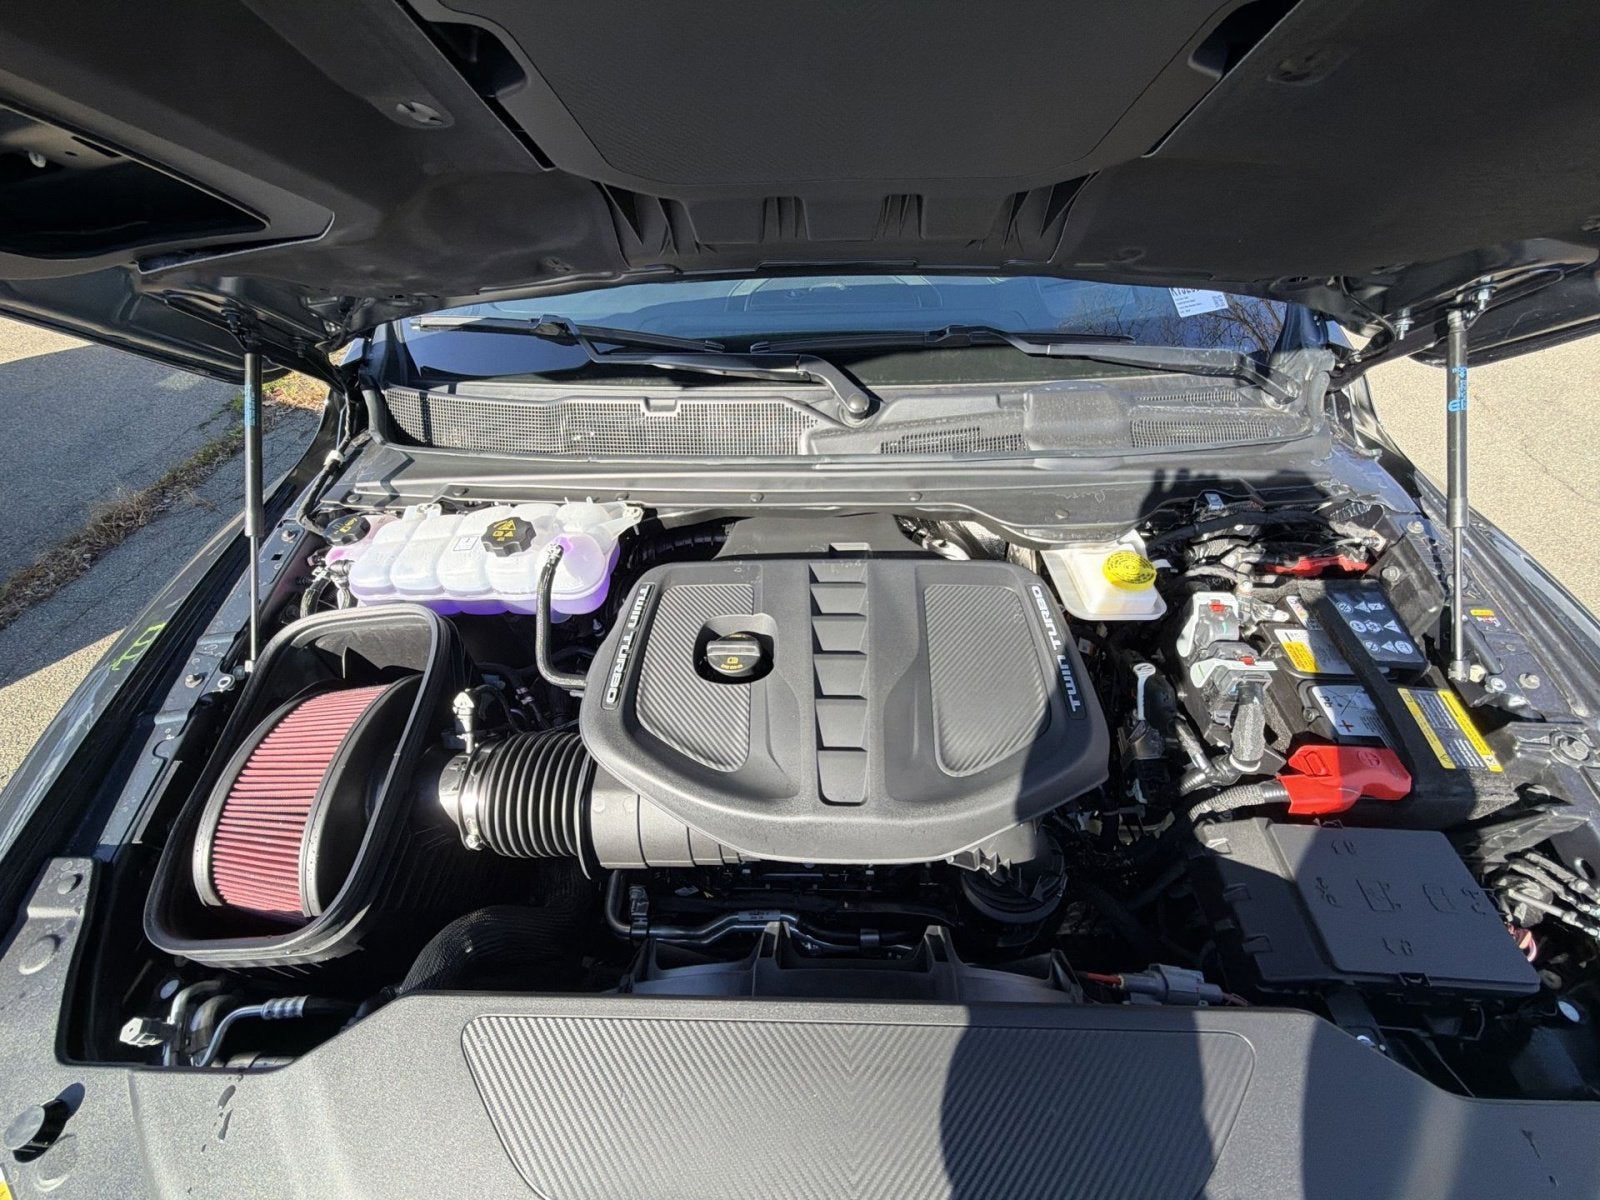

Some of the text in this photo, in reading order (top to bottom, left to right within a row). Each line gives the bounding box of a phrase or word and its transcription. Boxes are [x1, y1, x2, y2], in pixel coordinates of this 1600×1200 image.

[606, 584, 651, 705] TWIN TURBO
[1031, 585, 1081, 712] TWIN TURBO
